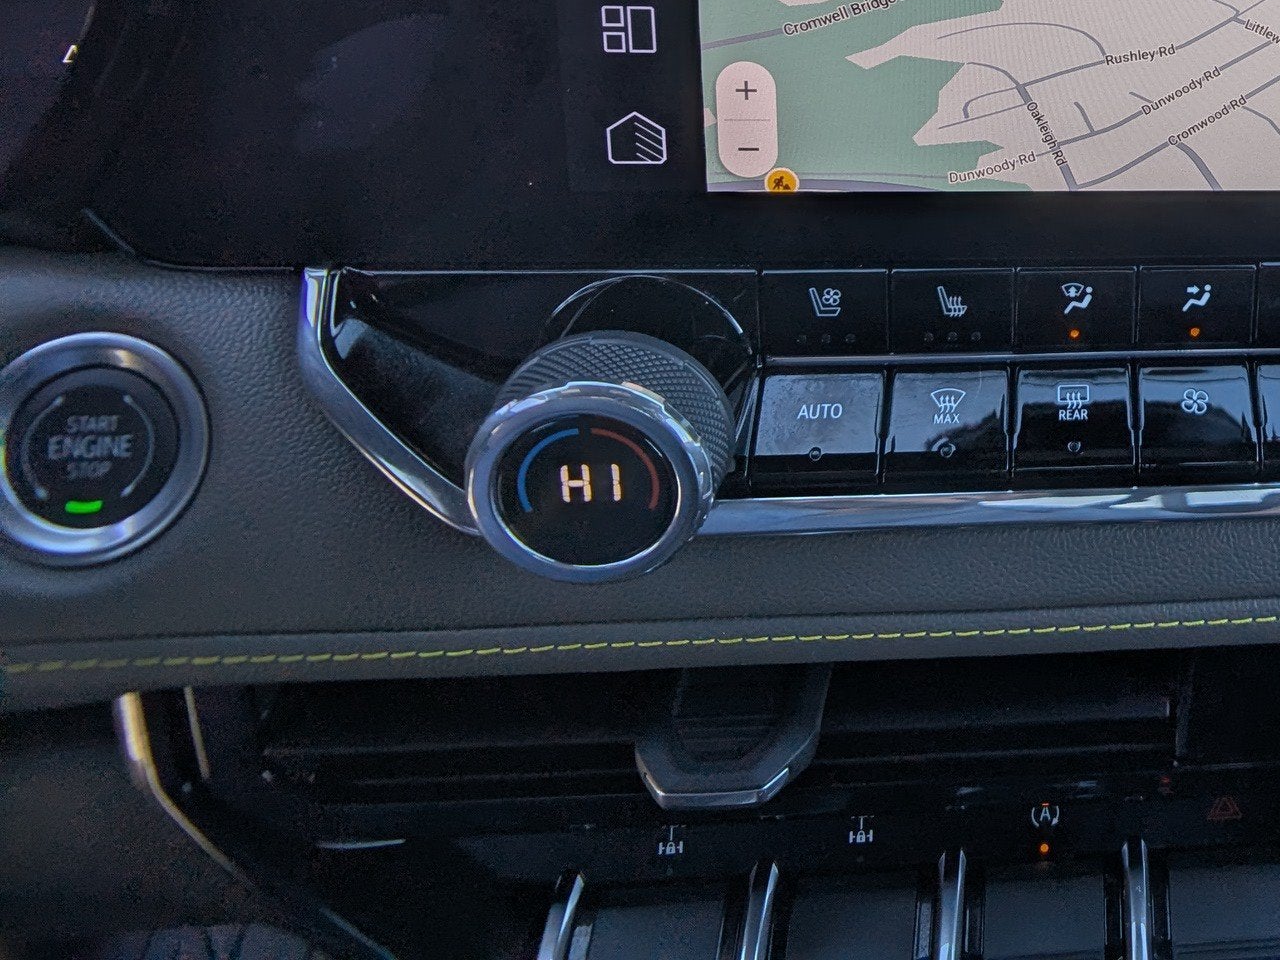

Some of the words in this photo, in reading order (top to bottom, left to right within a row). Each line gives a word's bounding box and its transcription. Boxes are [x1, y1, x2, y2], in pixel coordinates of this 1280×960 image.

[783, 7, 850, 36] Cromwell
[1105, 50, 1153, 66] Rushley
[1155, 44, 1176, 59] Rd
[1142, 75, 1205, 116] Dunwoody
[1203, 66, 1221, 83] Rd
[1026, 101, 1058, 151] Oakleigh
[1051, 148, 1068, 167] Rd
[1168, 102, 1231, 146] Cromwood
[1228, 95, 1247, 111] Rd
[949, 159, 1017, 183] Dunwoody
[1018, 151, 1037, 166] Rd
[797, 403, 843, 420] AUTO
[933, 412, 960, 425] MAX
[1058, 408, 1089, 422] REAR
[48, 434, 134, 460] ENGINE
